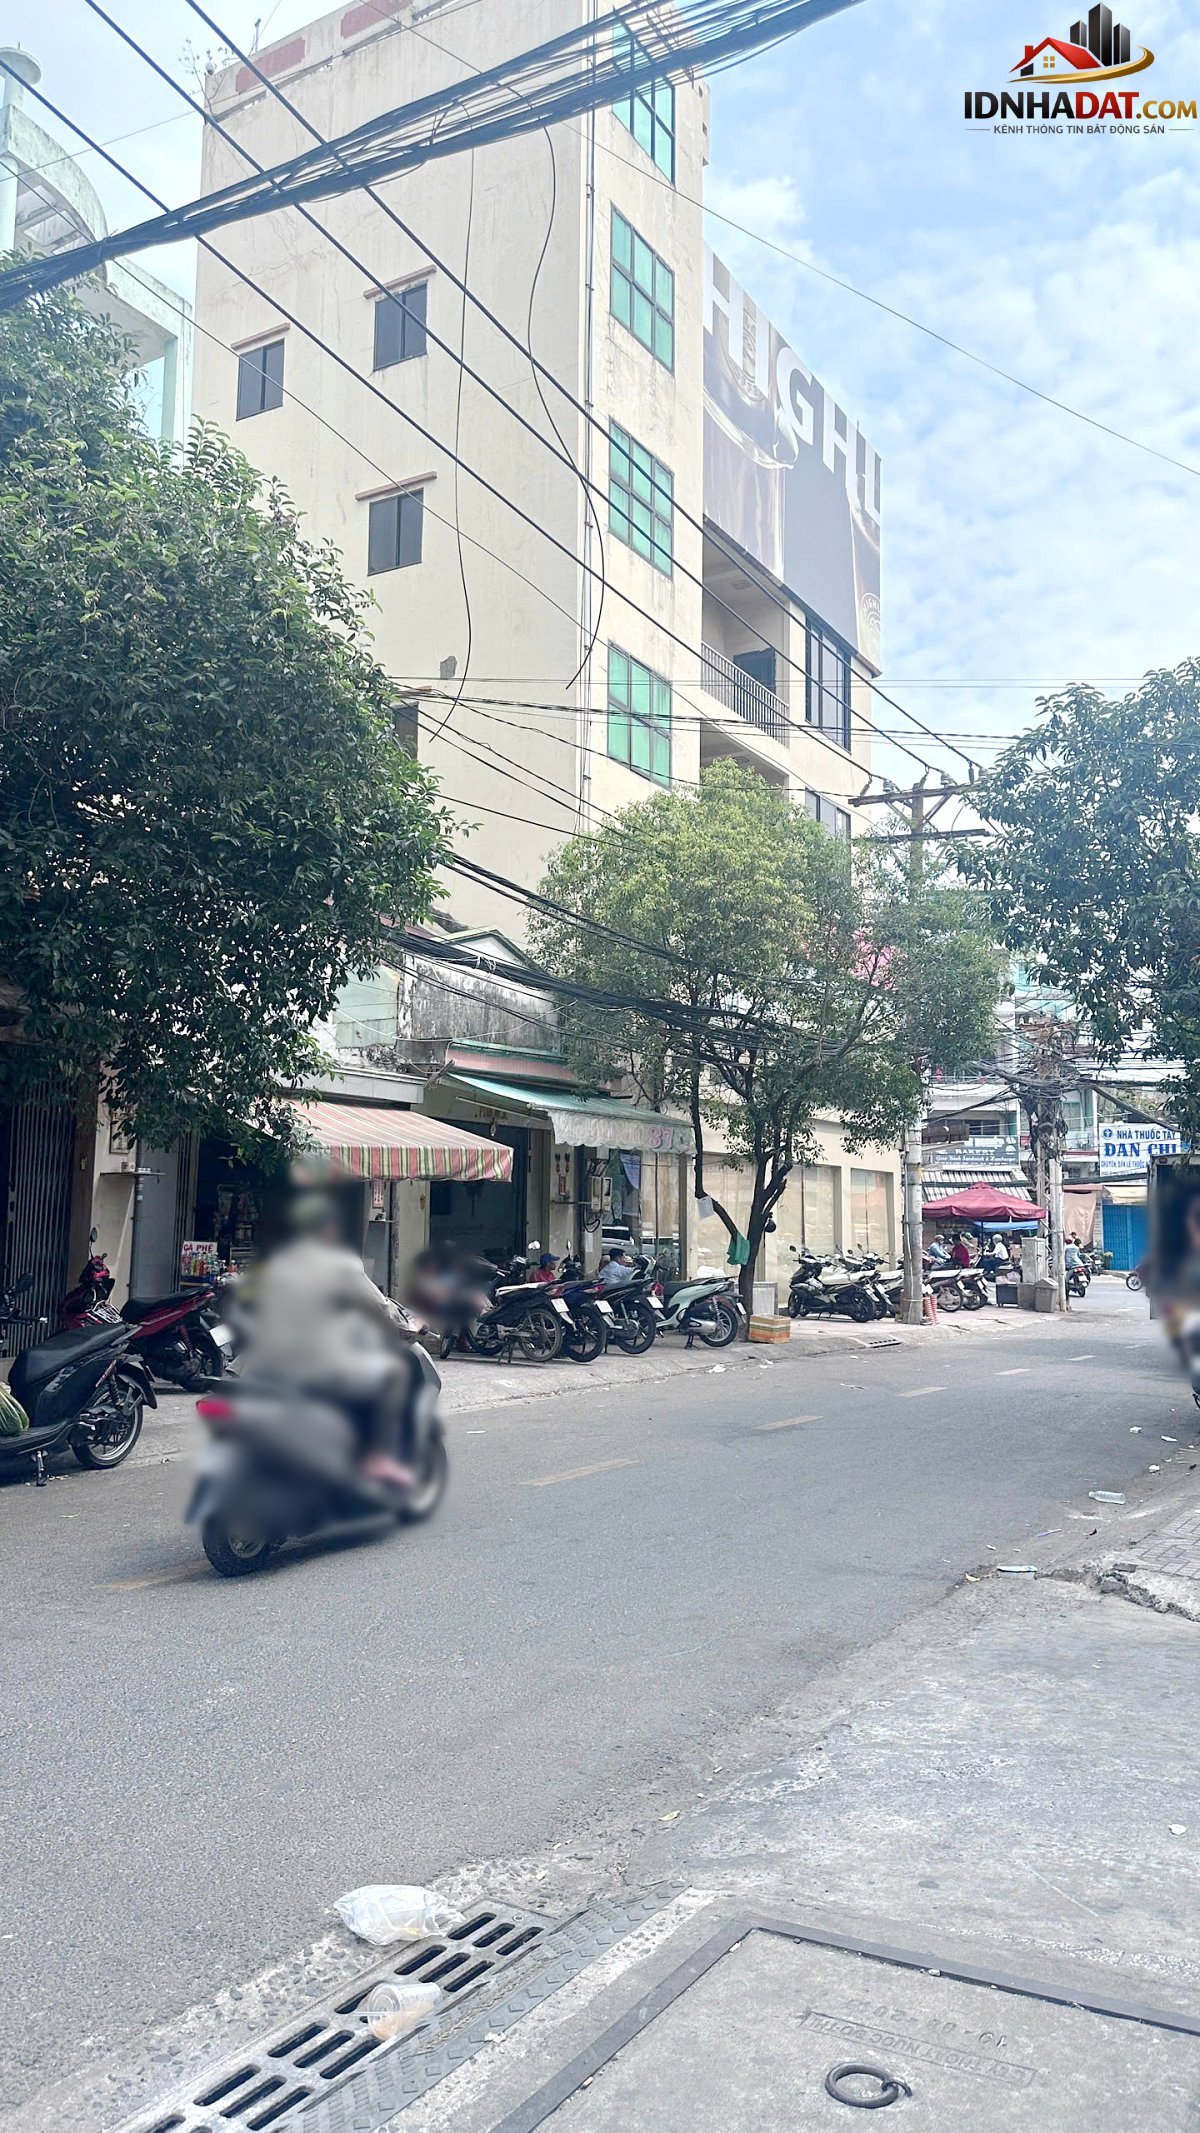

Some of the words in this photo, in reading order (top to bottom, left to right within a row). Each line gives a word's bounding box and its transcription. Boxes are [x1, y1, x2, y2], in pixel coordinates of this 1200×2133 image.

[648, 1126, 674, 1149] 87
[1117, 1128, 1133, 1140] NHÀ
[1135, 1126, 1161, 1140] THUỐC
